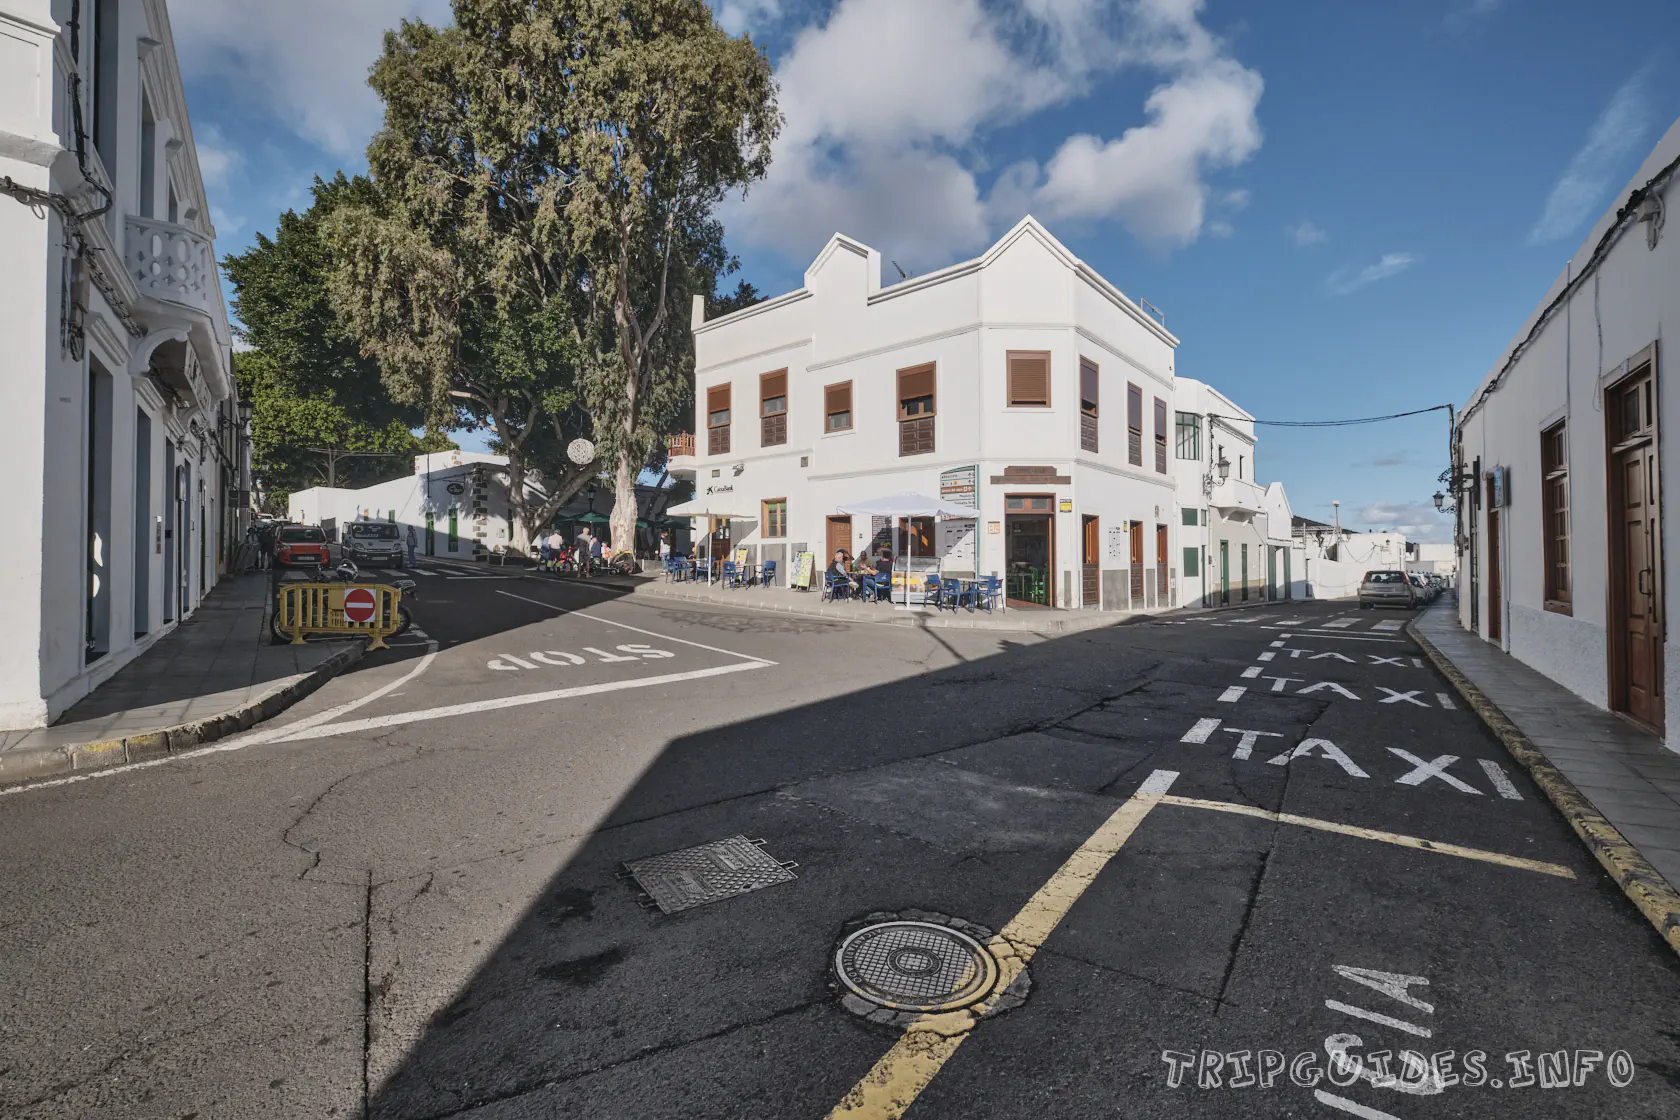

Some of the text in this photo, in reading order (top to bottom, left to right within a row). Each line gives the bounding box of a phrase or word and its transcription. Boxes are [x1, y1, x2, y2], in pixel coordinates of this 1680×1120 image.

[487, 644, 675, 671] STOP
[1282, 648, 1425, 668] TAXI
[1262, 676, 1457, 710] TAXI
[1223, 727, 1524, 801] TAXI
